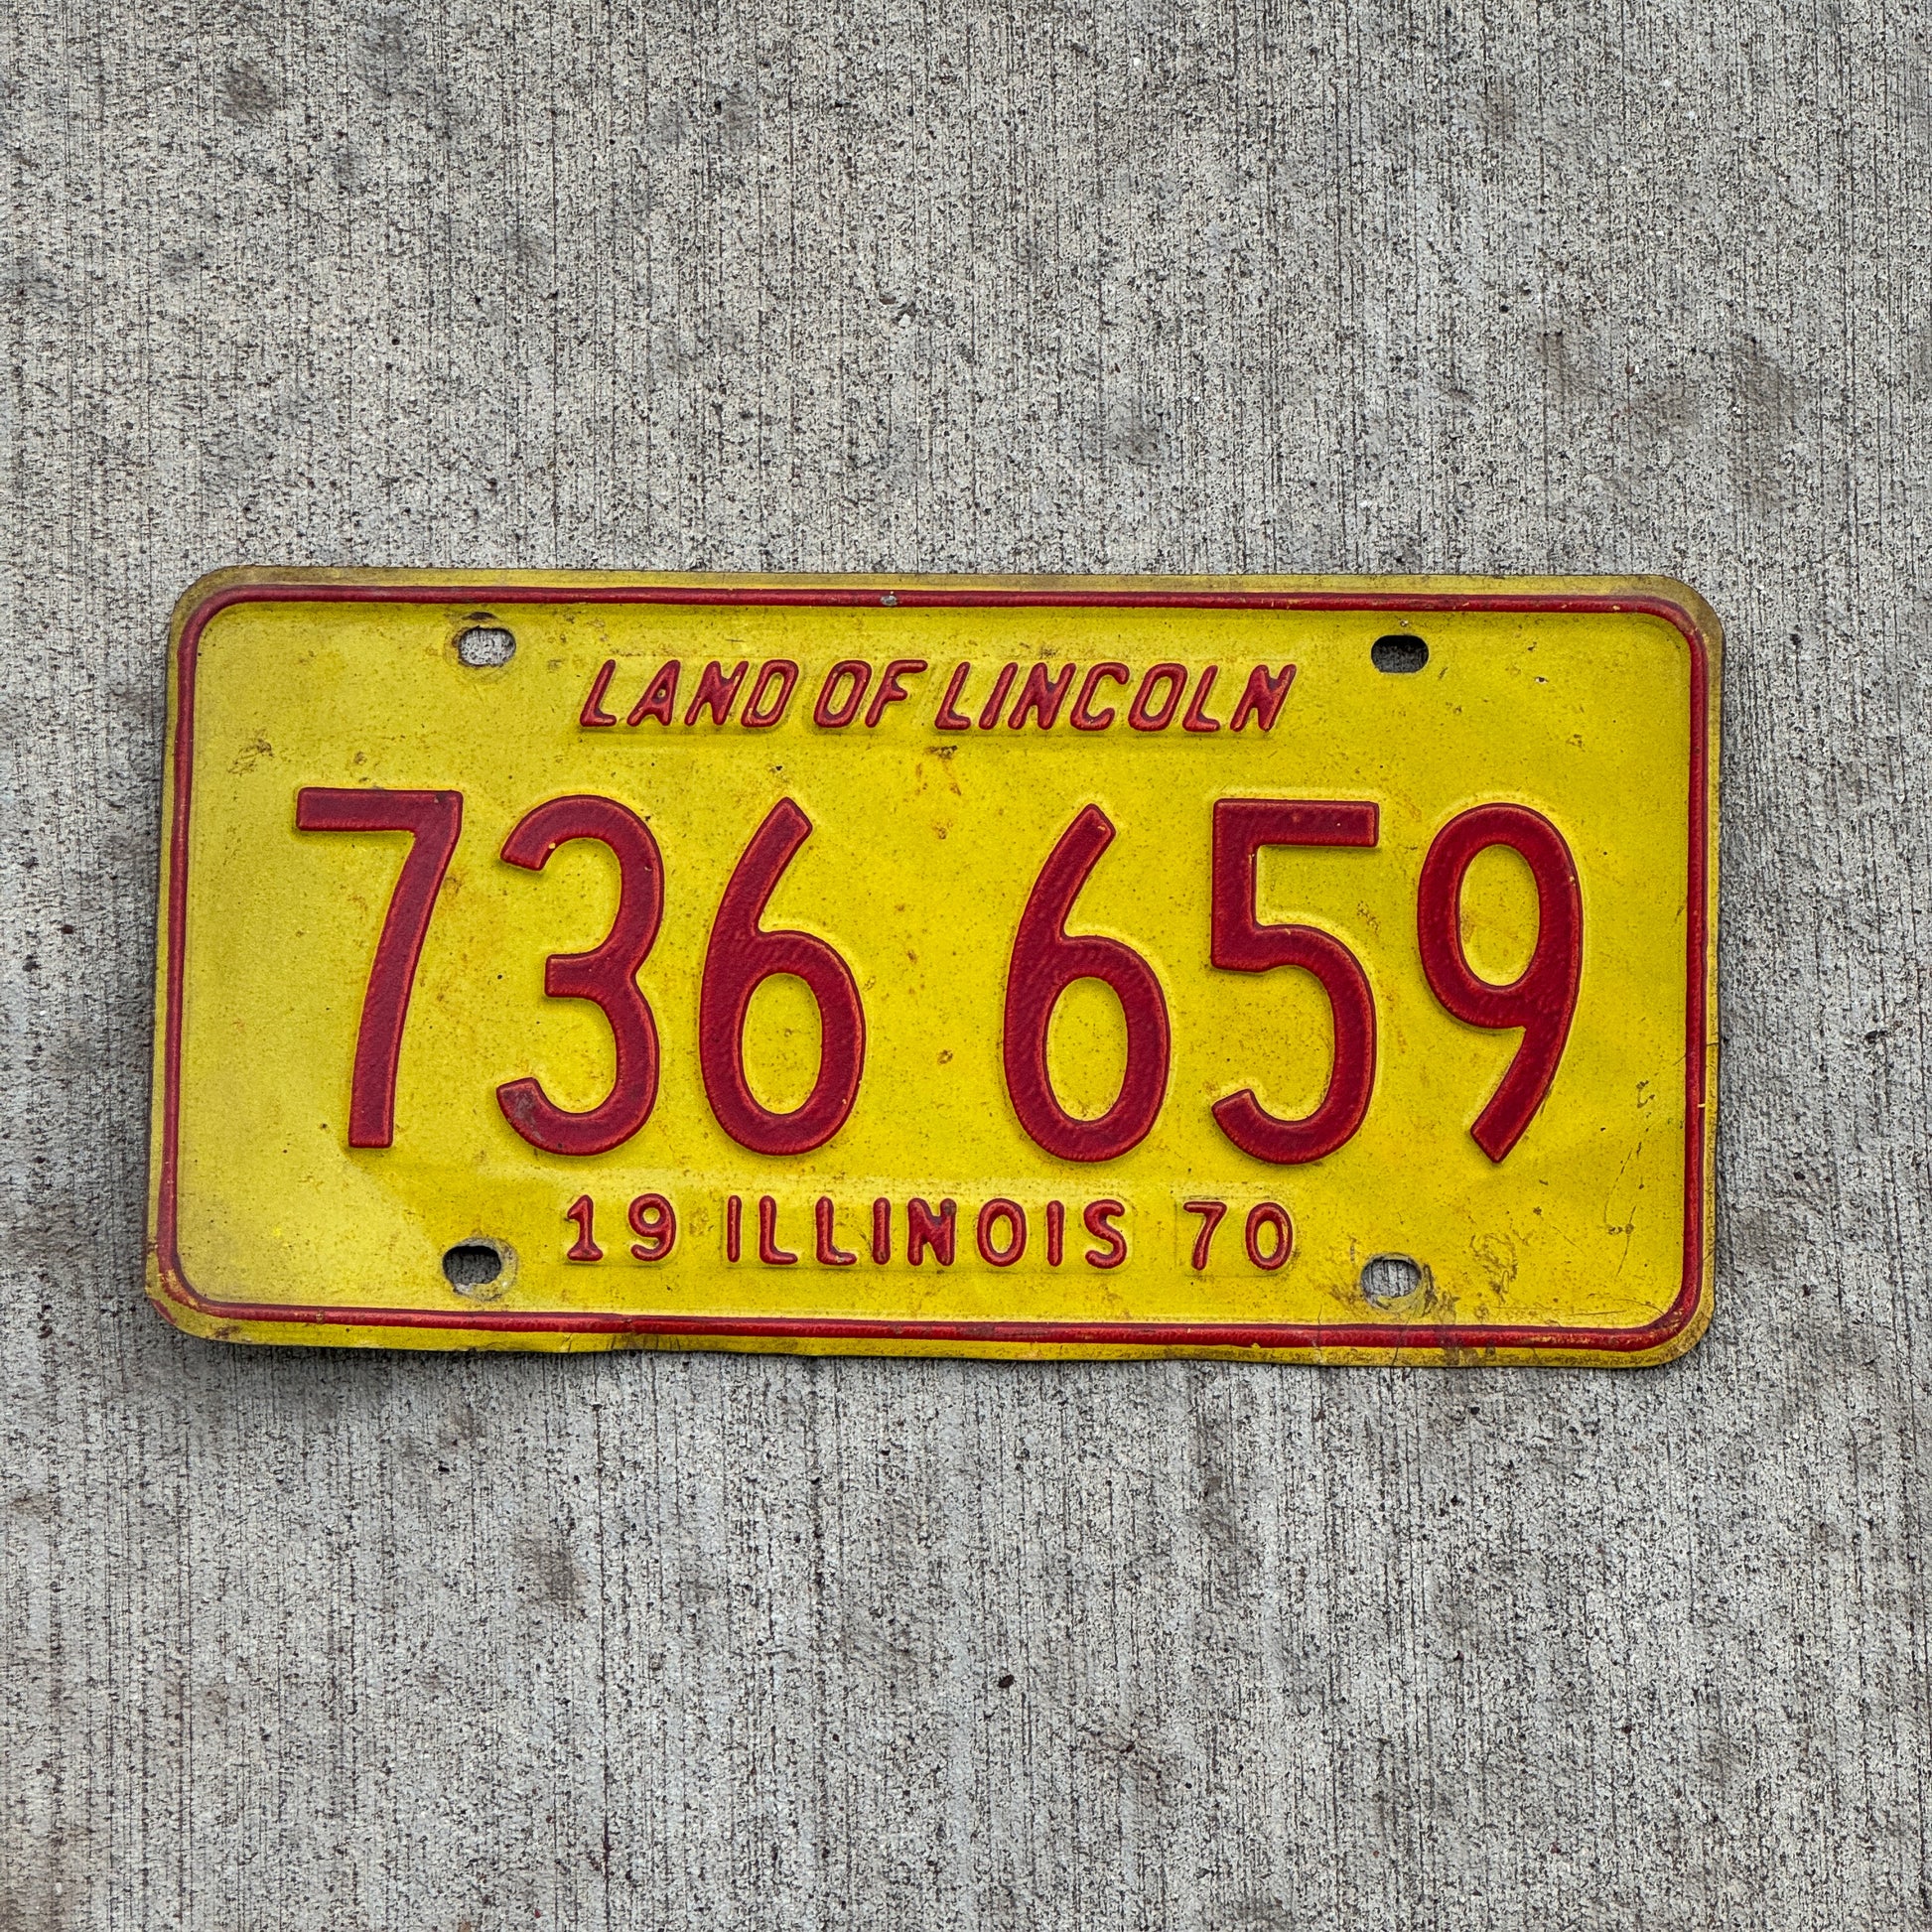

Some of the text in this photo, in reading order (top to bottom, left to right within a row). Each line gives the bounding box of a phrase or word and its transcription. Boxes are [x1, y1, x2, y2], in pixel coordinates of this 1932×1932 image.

[581, 659, 1297, 733] LAND OF LINCOLN
[297, 787, 1584, 1166] 736 659
[567, 1193, 1293, 1272] 19 ILLINOIS 70
